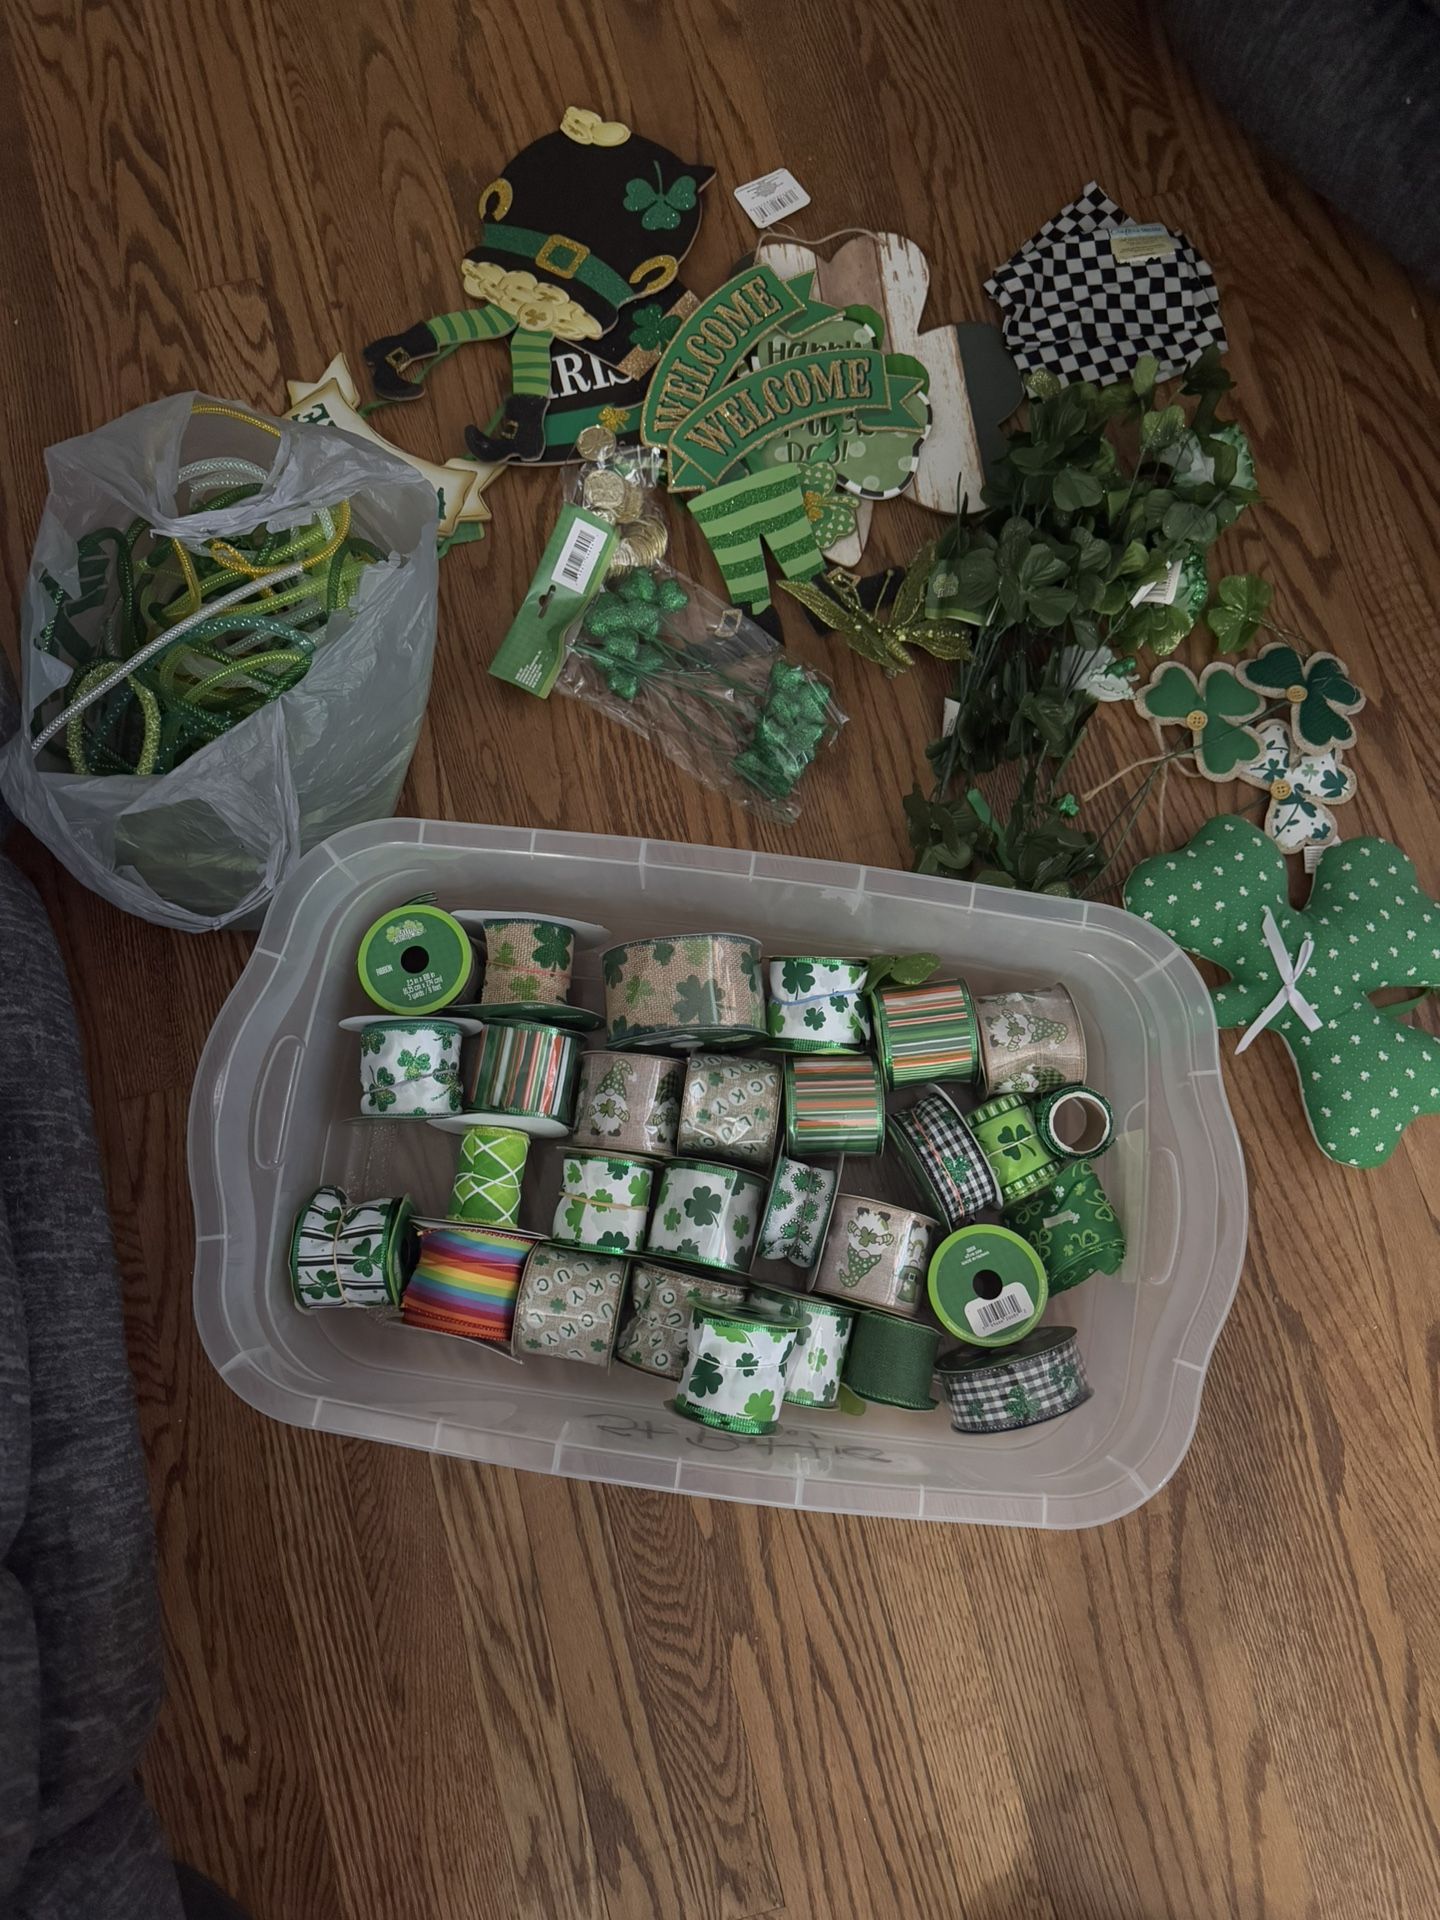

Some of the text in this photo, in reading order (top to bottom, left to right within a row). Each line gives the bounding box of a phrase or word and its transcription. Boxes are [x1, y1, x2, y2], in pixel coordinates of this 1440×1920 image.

[549, 353, 632, 400] RI
[653, 275, 782, 433] WELCOME
[684, 358, 872, 456] WELCOME
